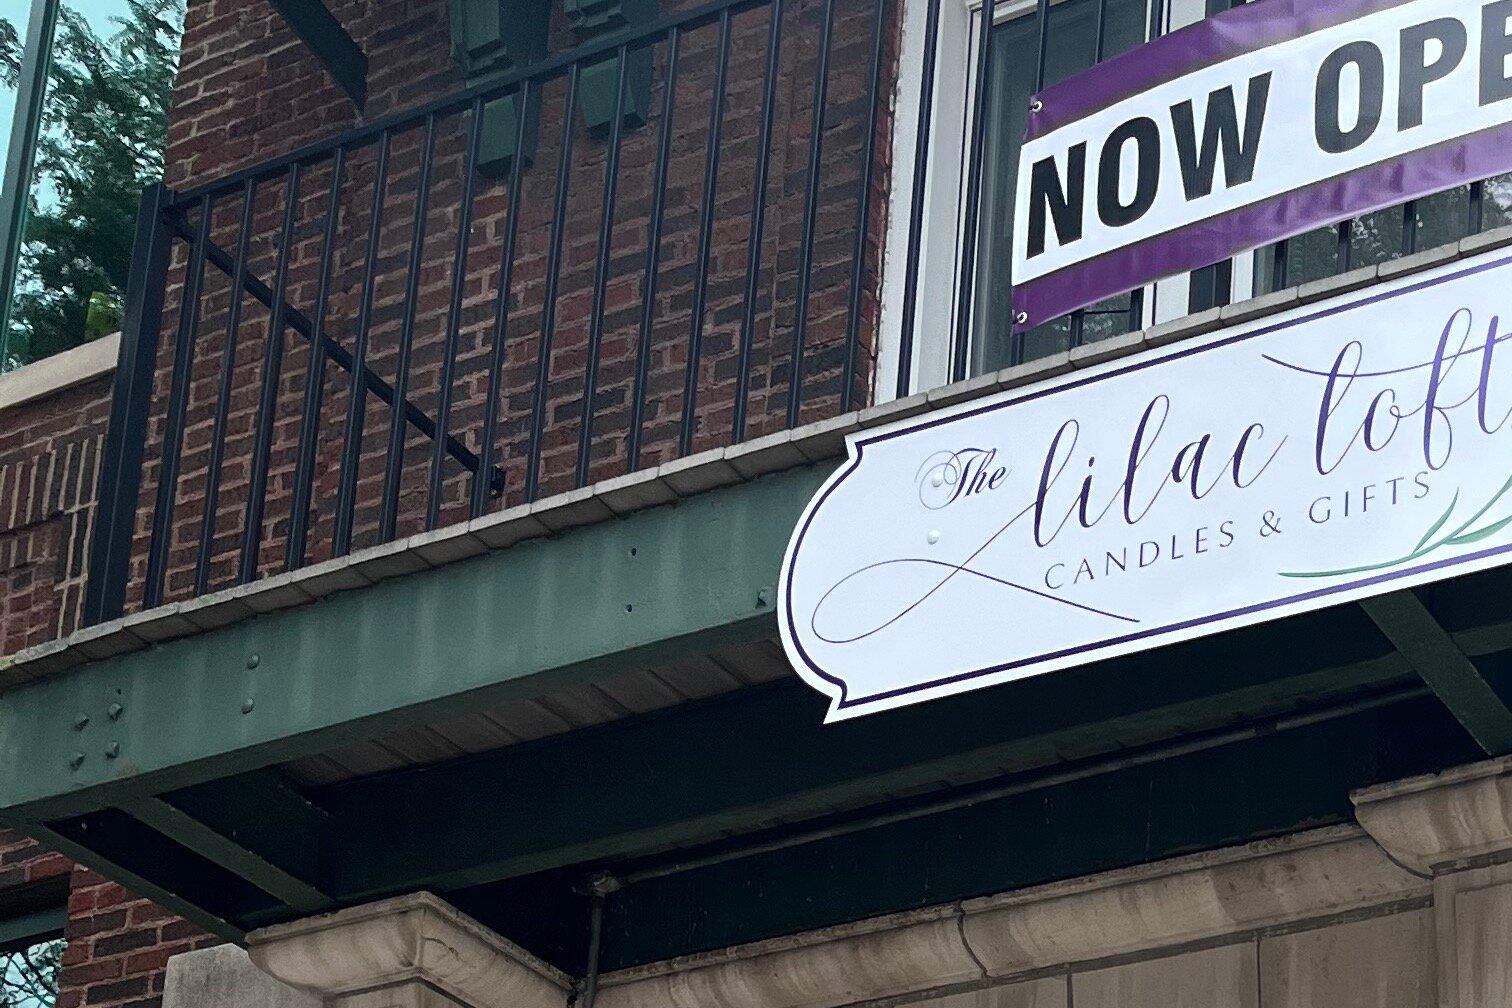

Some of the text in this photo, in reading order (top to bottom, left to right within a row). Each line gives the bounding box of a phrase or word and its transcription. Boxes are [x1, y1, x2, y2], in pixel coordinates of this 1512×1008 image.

[1024, 71, 1273, 260] NOW
[915, 446, 1012, 510] The
[1031, 394, 1288, 548] lilac
[1044, 469, 1432, 591] CANDLES & GIFTS
